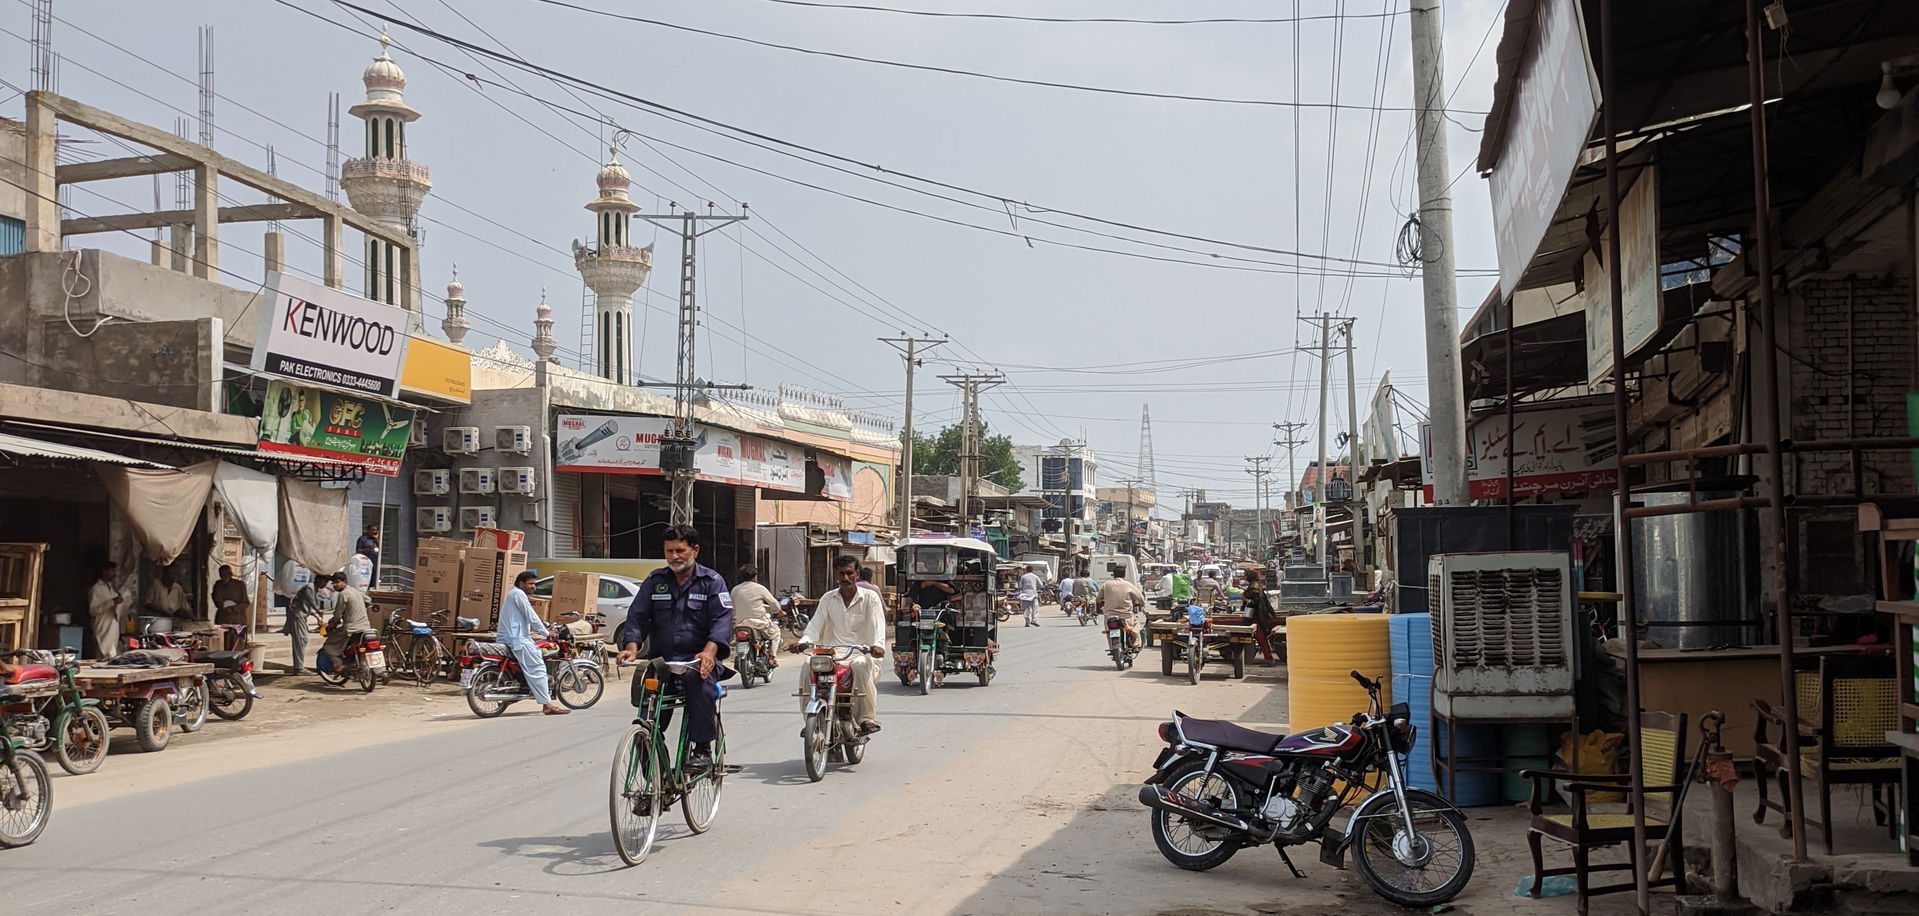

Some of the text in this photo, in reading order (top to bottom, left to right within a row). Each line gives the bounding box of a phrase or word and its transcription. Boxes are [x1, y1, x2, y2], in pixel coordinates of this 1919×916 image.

[283, 298, 394, 355] KENWOOD
[279, 360, 296, 374] PAK
[295, 364, 343, 384] ELECTRONICS
[329, 399, 365, 429] GFC
[328, 426, 358, 437] FANS
[491, 559, 504, 619] REFRIGERATOR
